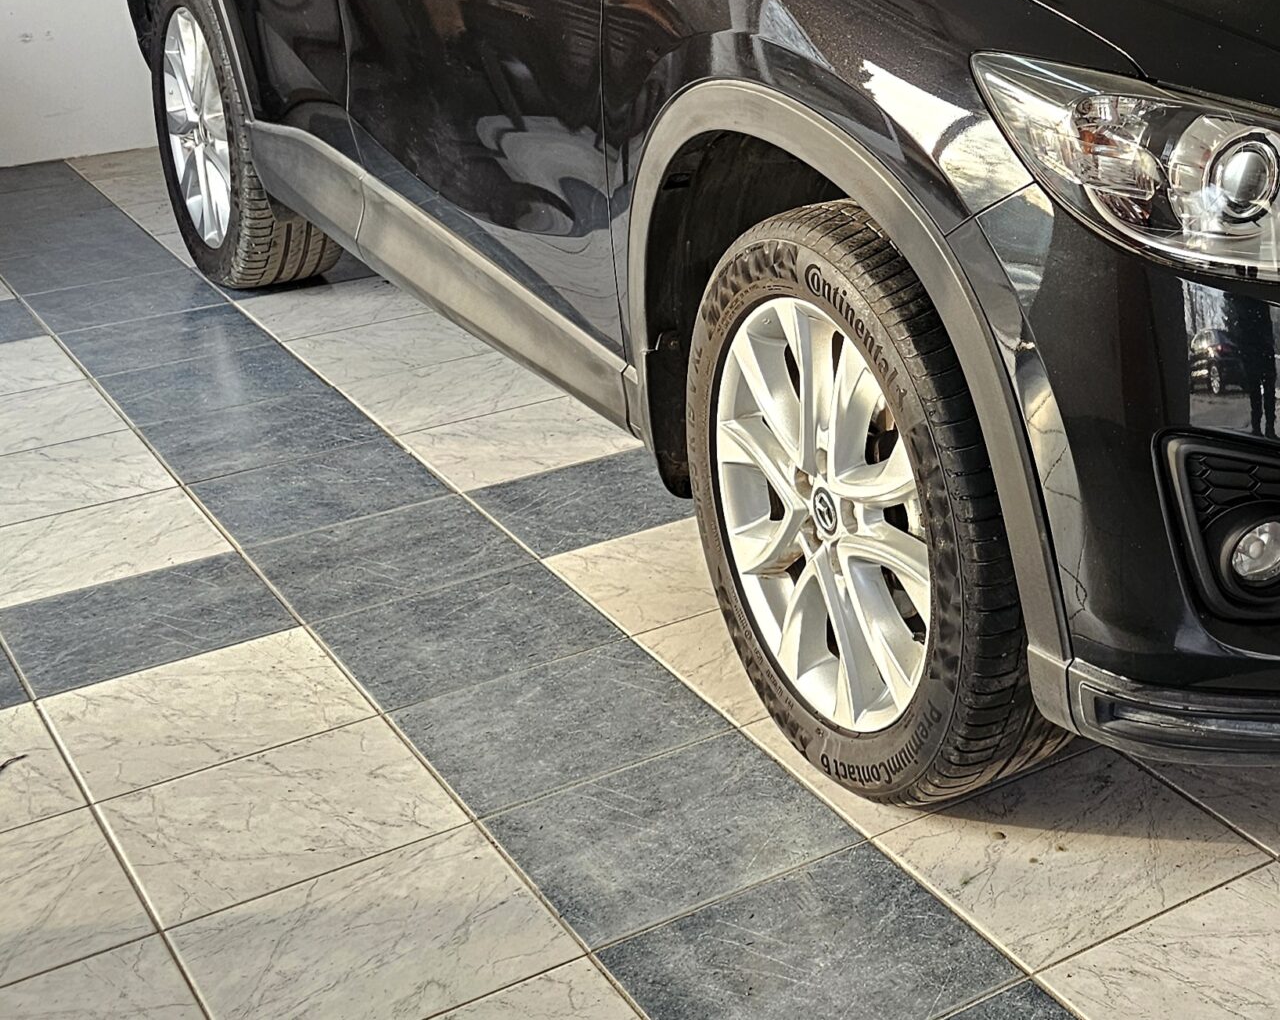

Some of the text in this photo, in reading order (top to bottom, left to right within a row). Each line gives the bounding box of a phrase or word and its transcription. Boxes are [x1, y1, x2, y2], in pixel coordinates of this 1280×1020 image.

[804, 263, 899, 393] Continental
[820, 699, 942, 786] PremiumContact 6
